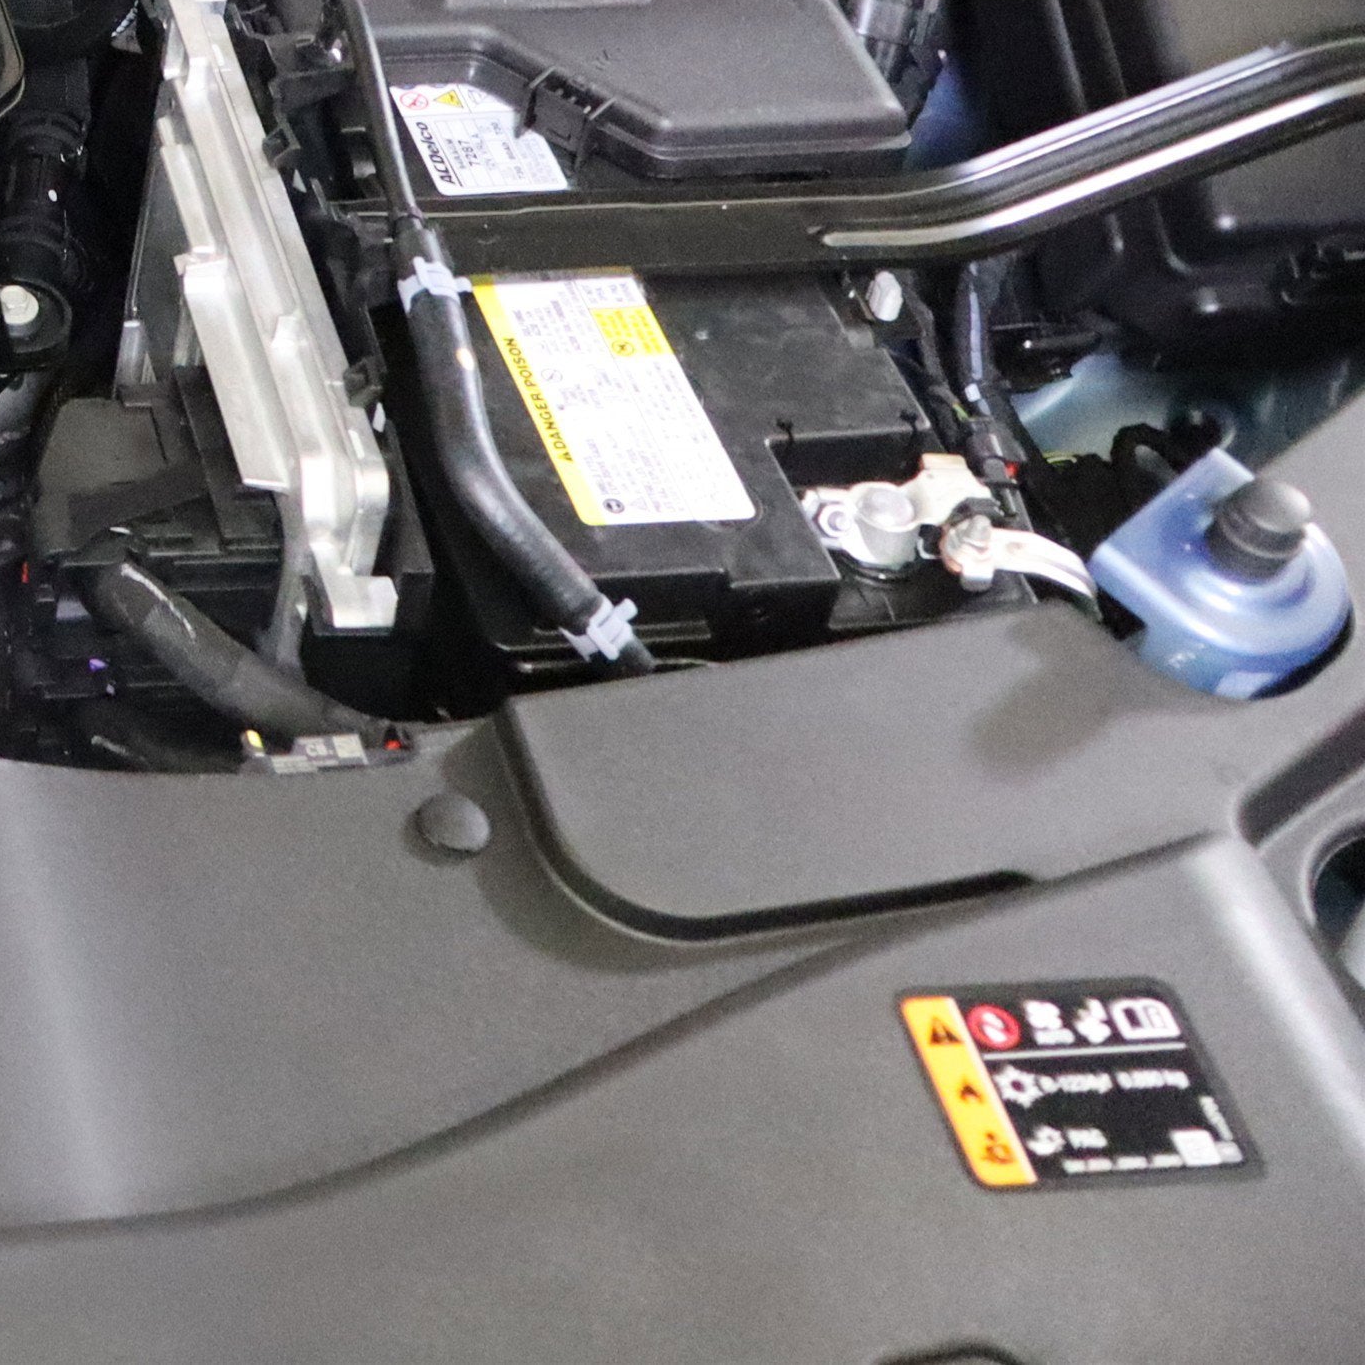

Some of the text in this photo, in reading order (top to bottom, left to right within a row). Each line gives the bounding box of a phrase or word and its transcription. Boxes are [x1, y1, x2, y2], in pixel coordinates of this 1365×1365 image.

[416, 121, 456, 185] ACDelco
[503, 337, 567, 451] DANGER POISON
